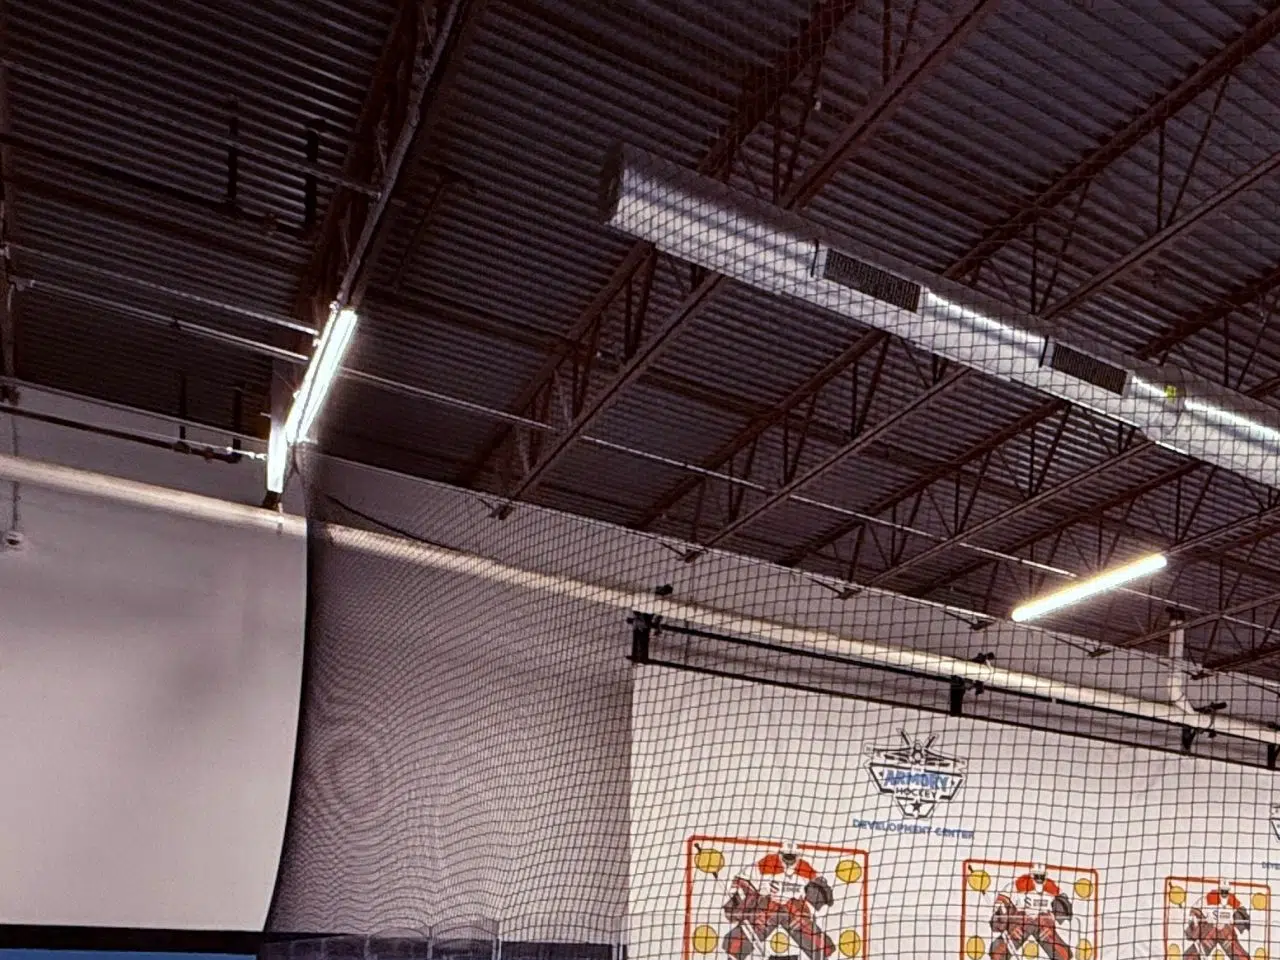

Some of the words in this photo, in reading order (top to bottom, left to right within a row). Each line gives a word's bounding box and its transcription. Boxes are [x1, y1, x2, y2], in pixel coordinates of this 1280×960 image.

[884, 769, 949, 792] ARMORY
[895, 787, 937, 798] HOCKEY
[852, 818, 931, 835] DEVELOPMENT
[935, 827, 974, 839] CENTER
